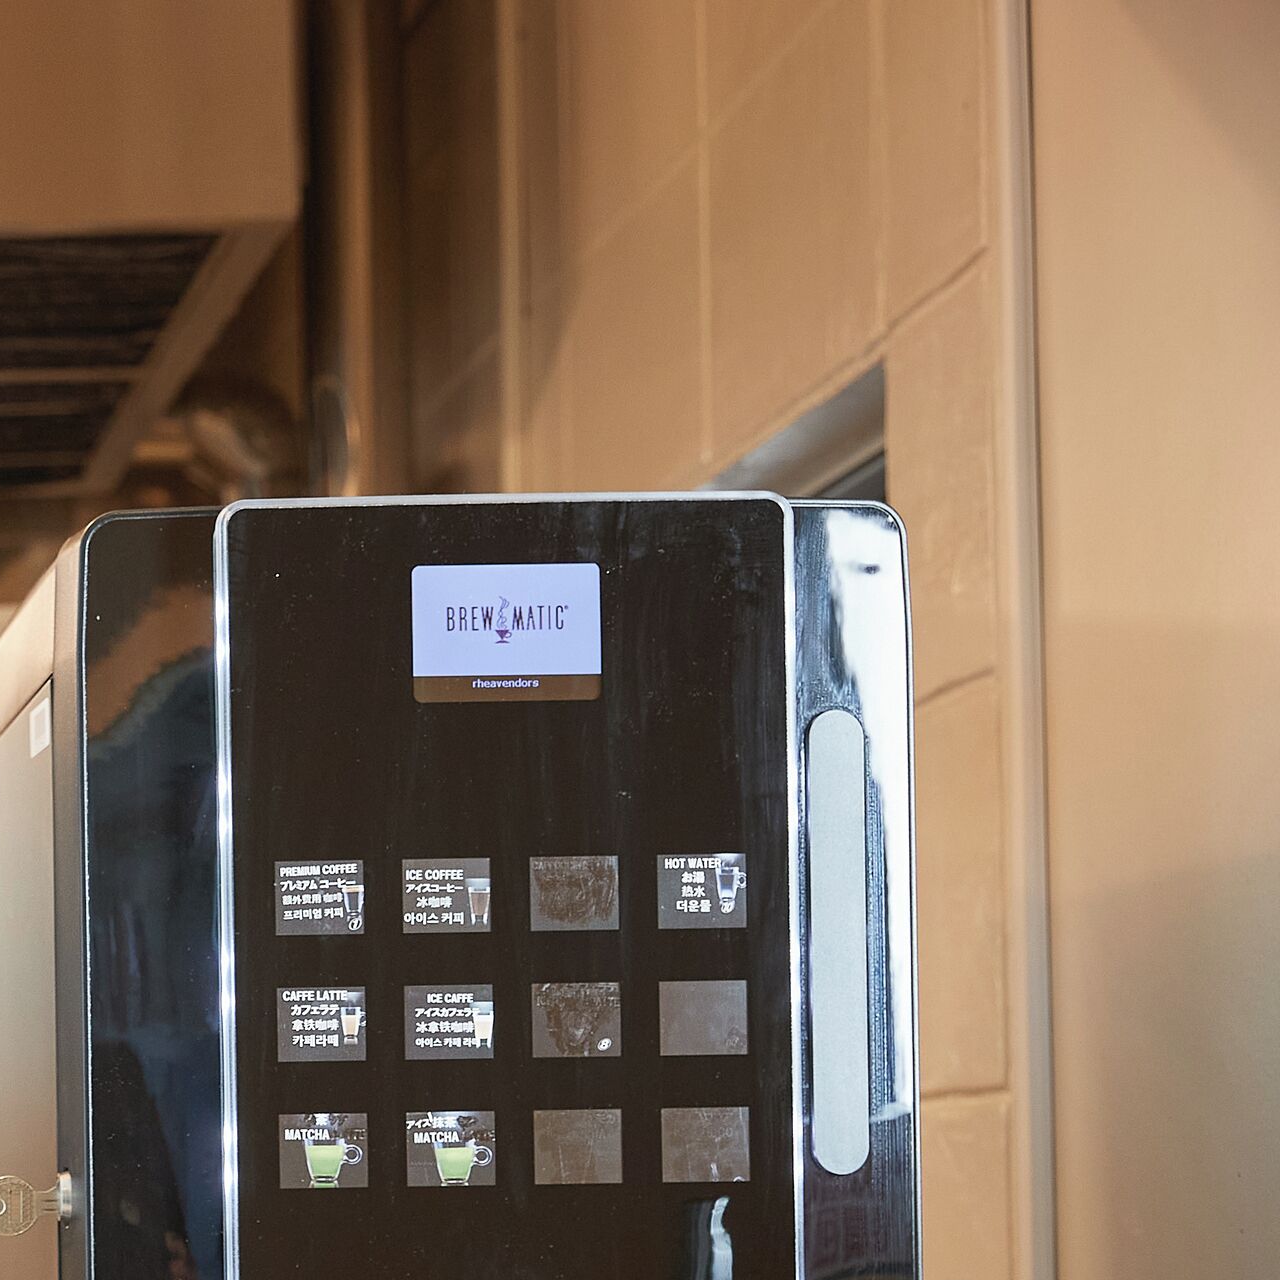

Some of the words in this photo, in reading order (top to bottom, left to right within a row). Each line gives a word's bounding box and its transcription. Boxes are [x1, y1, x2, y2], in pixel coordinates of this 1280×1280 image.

[472, 678, 539, 688] rheavendors
[664, 858, 686, 869] HOT
[687, 857, 721, 869] WATER
[280, 865, 320, 877] PREMIUM
[322, 863, 358, 875] COFFEE
[405, 869, 423, 880] ICE
[424, 869, 464, 880] COFFEE
[282, 990, 315, 1001] CAFFE
[316, 990, 347, 1001] LATTE
[426, 993, 443, 1003] ICE
[444, 993, 474, 1003] CAFFE
[290, 1004, 339, 1016] カフェラテ
[284, 1128, 330, 1140] MATCHA
[413, 1131, 459, 1144] MATCHA
